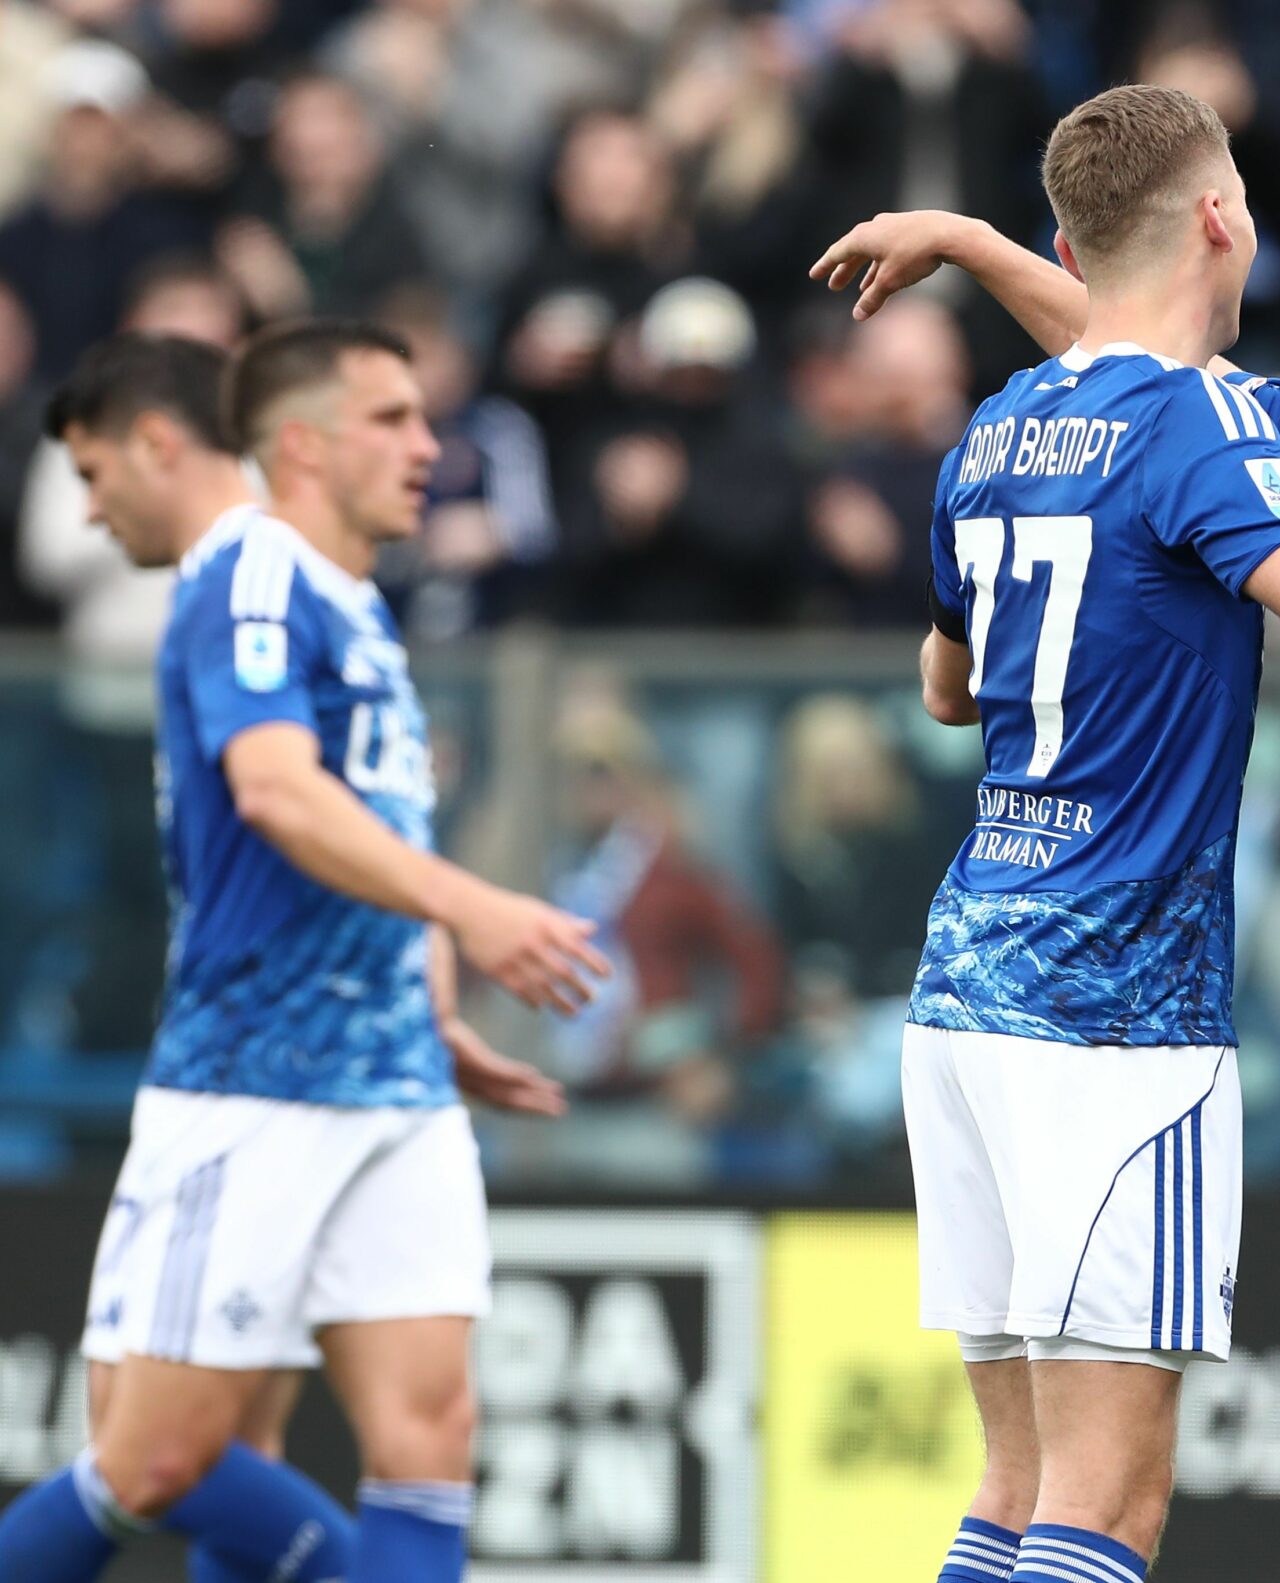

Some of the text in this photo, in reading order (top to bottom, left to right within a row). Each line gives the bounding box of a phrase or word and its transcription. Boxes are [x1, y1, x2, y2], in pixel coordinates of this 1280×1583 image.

[1012, 417, 1129, 478] BREMPT
[954, 515, 1093, 778] 77
[977, 788, 1094, 834] EUBERGER
